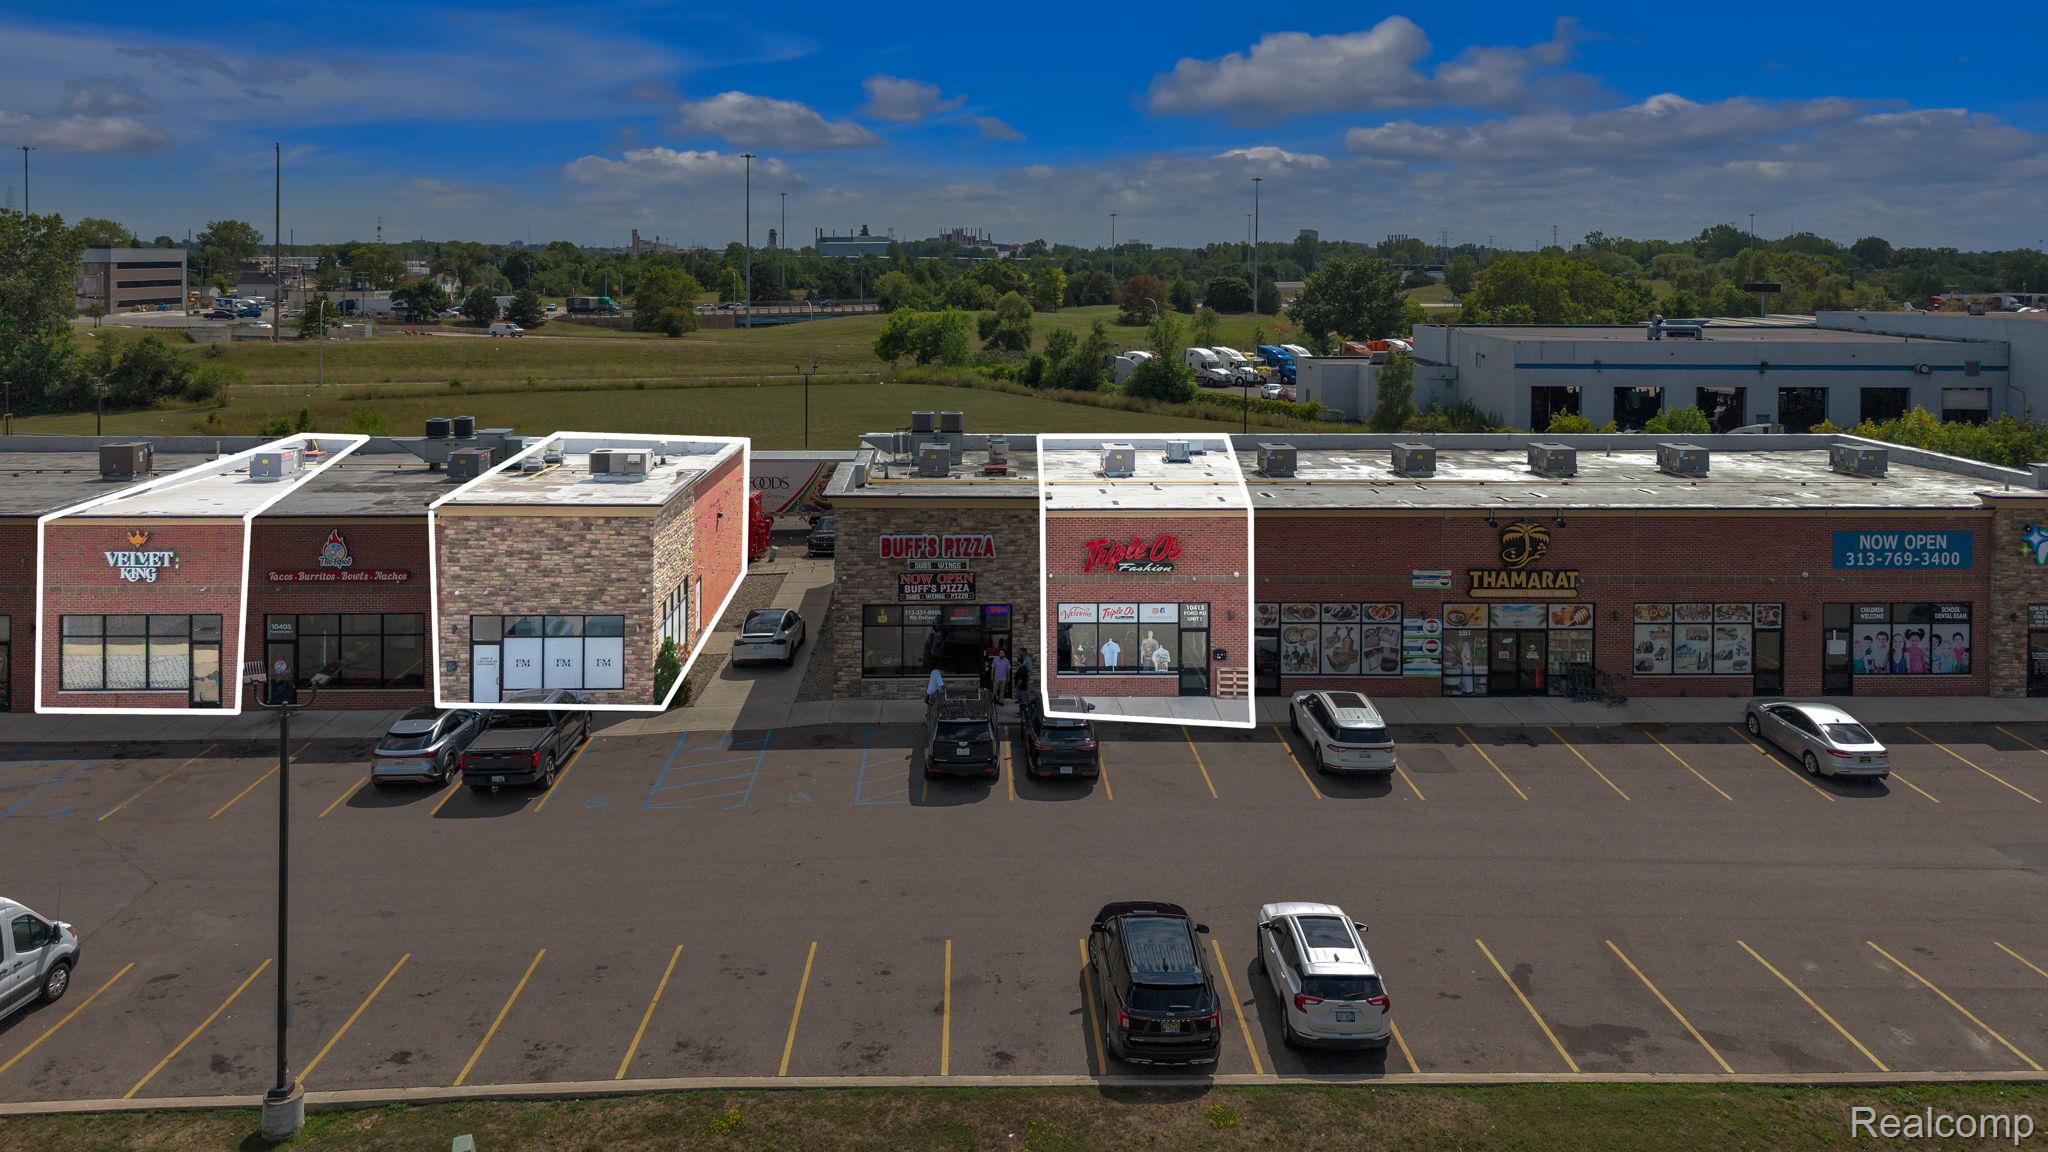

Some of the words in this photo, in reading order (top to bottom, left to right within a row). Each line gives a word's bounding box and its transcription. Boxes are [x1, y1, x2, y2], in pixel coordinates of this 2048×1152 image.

[880, 534, 940, 559] BUFF'S
[942, 534, 996, 559] PIZZA
[1859, 535, 1898, 550] NOW
[1904, 534, 1947, 550] OPEN
[104, 551, 174, 567] VELVET
[1084, 536, 1148, 573] Triple
[1846, 552, 1960, 566] 313-769-3400
[120, 567, 157, 583] KING
[1118, 562, 1172, 572] Fashion
[268, 571, 293, 580] Tacos
[299, 571, 335, 580] Burritos
[341, 571, 368, 580] Bowls
[375, 571, 407, 580] Nachos
[900, 574, 933, 584] NOW
[937, 573, 974, 584] OPEN
[1470, 570, 1579, 588] THAMARAT
[904, 585, 937, 593] BUFF'S
[940, 584, 970, 593] PIZZA
